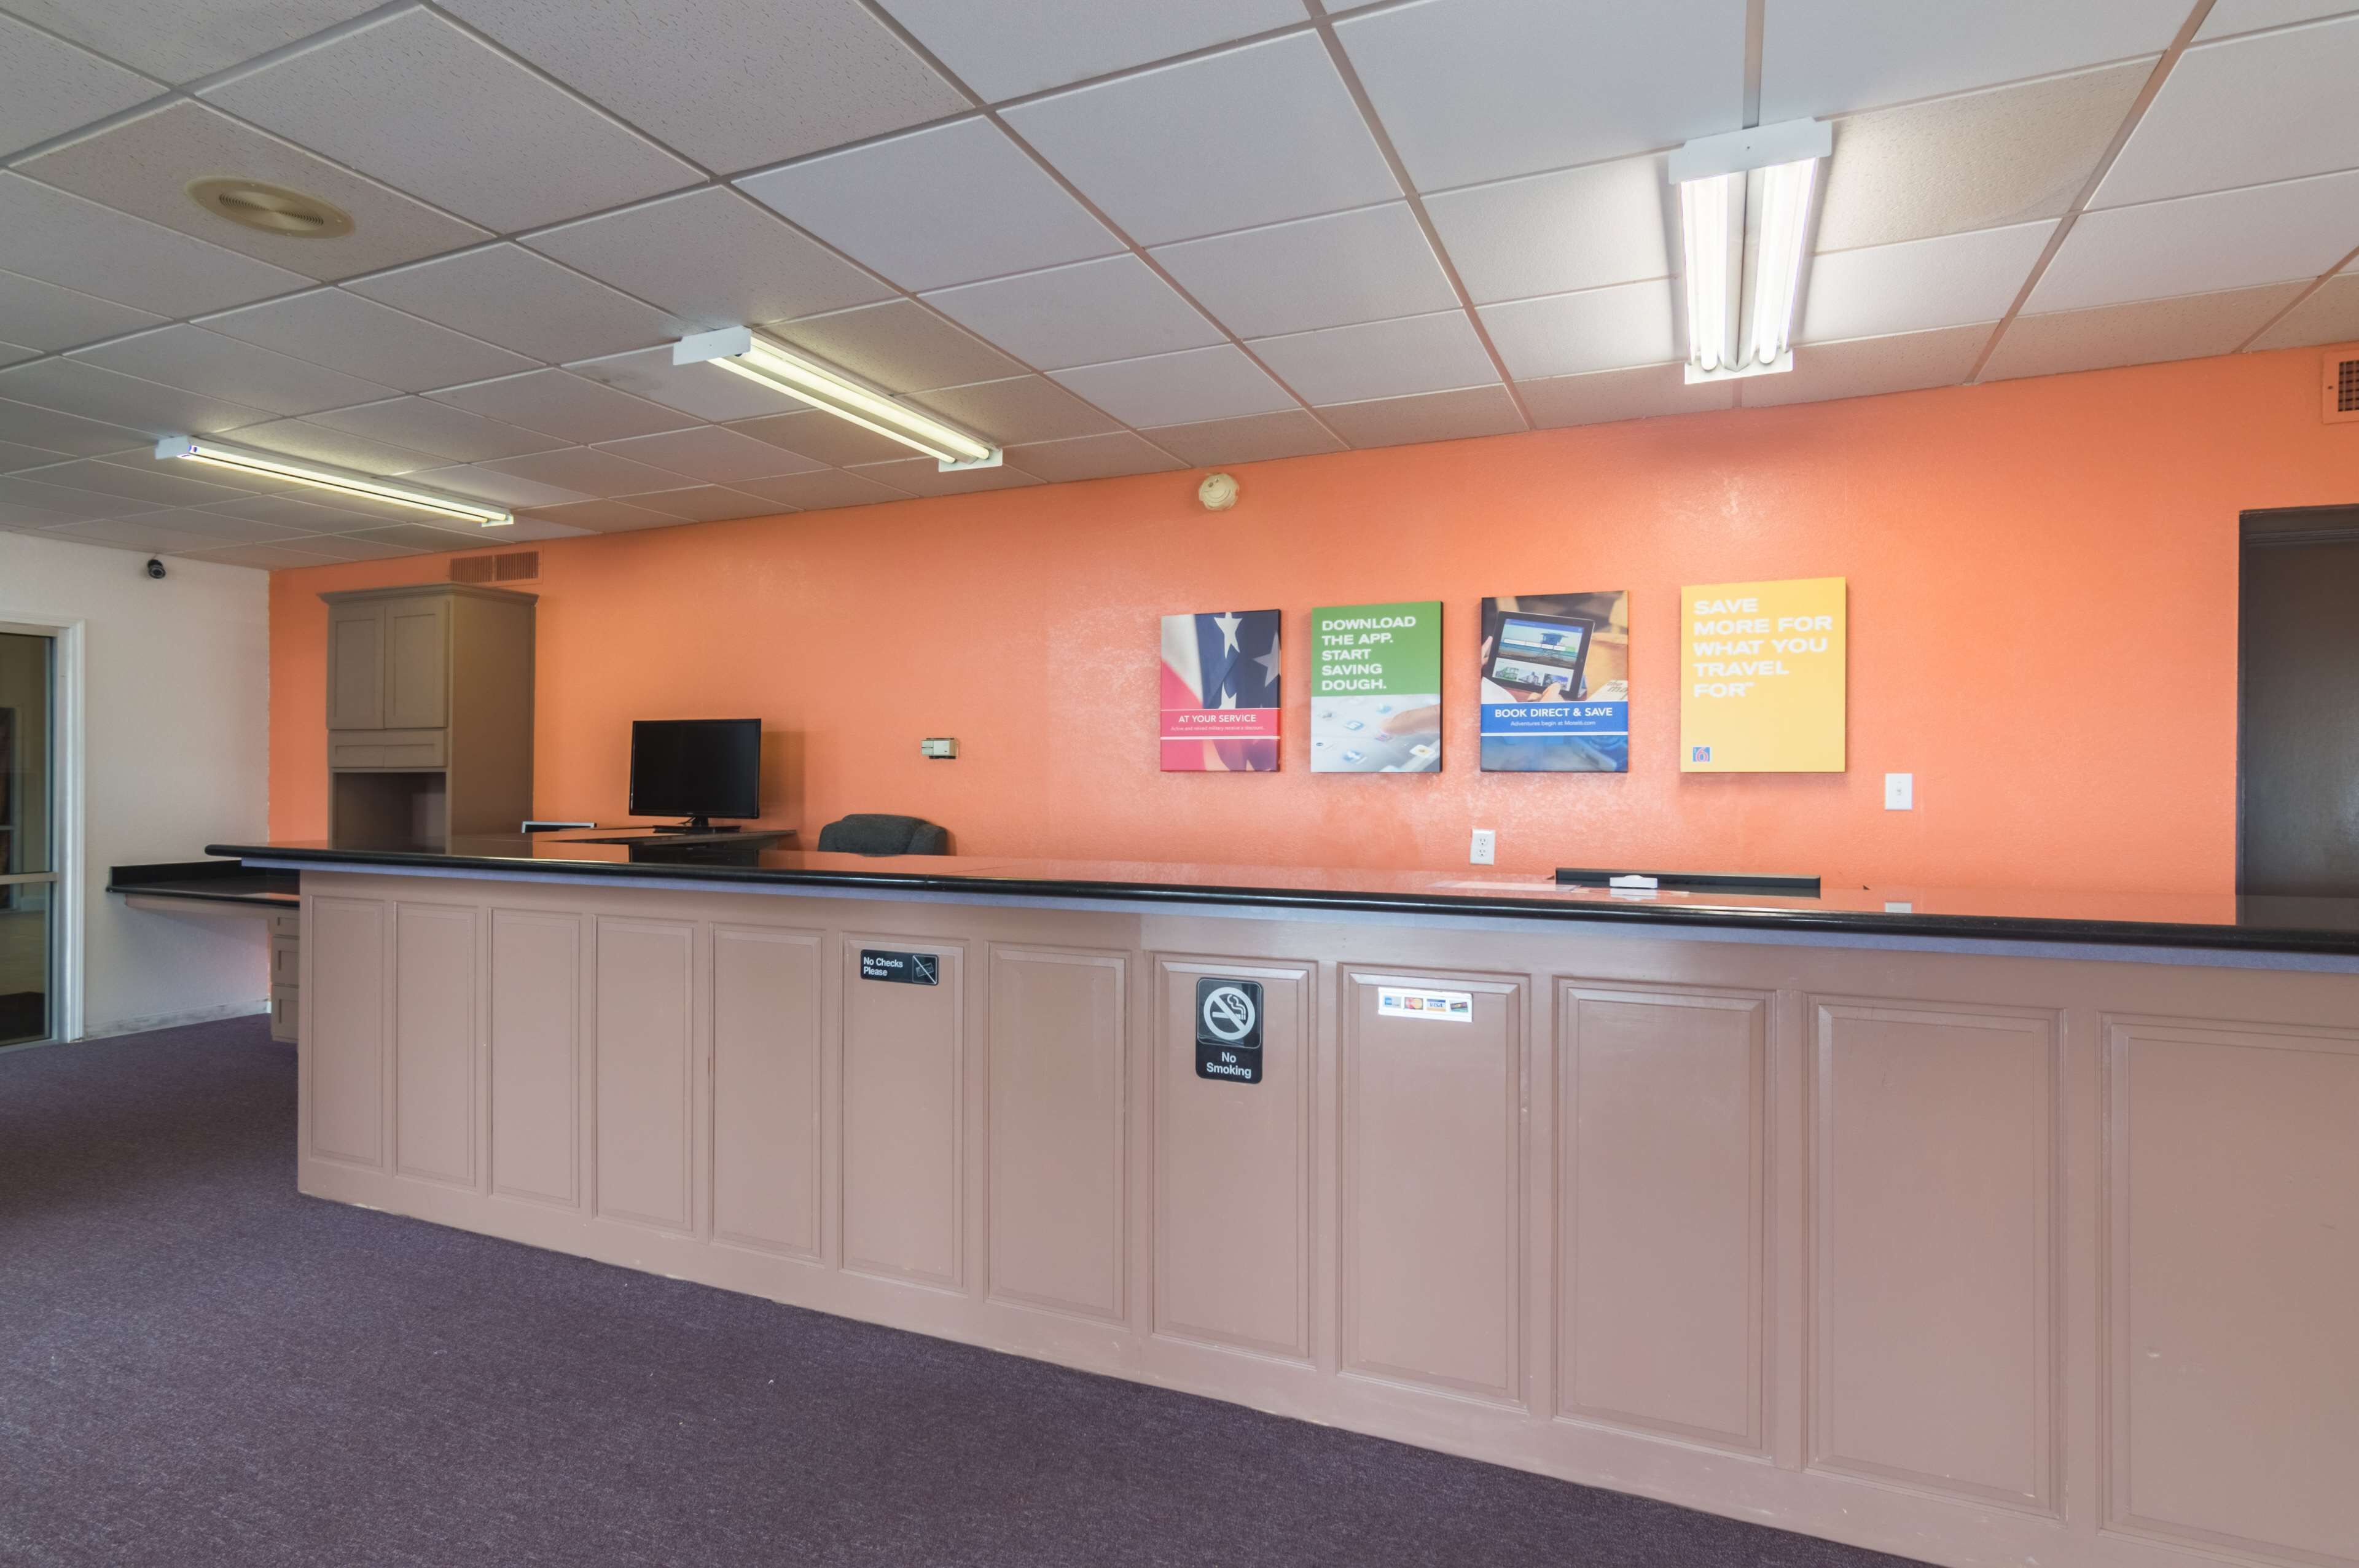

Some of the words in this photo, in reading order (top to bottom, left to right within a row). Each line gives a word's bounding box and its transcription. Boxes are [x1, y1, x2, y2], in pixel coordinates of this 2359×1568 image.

[1694, 598, 1759, 615] SAVE
[1322, 616, 1416, 631] DOWNLOAD
[1694, 618, 1770, 636] MORE
[1778, 615, 1833, 633] FOR
[1322, 634, 1354, 646] THE
[1358, 633, 1393, 644] APP.
[1692, 640, 1764, 657] WHAT
[1770, 638, 1828, 653] YOU
[1322, 649, 1371, 661] START
[1322, 663, 1382, 676] SAVING
[1692, 660, 1790, 677] TRAVEL
[1322, 679, 1387, 691] DOUGH.
[1495, 709, 1527, 717] BOOK
[1530, 708, 1570, 717] DIRECT
[1573, 708, 1581, 717] &
[1585, 707, 1613, 716] SAVE
[1696, 746, 1709, 762] 6
[863, 957, 874, 965] No
[875, 958, 903, 968] Checks
[863, 966, 888, 976] Please
[1221, 1051, 1236, 1063] No
[1206, 1062, 1251, 1078] Smoking
